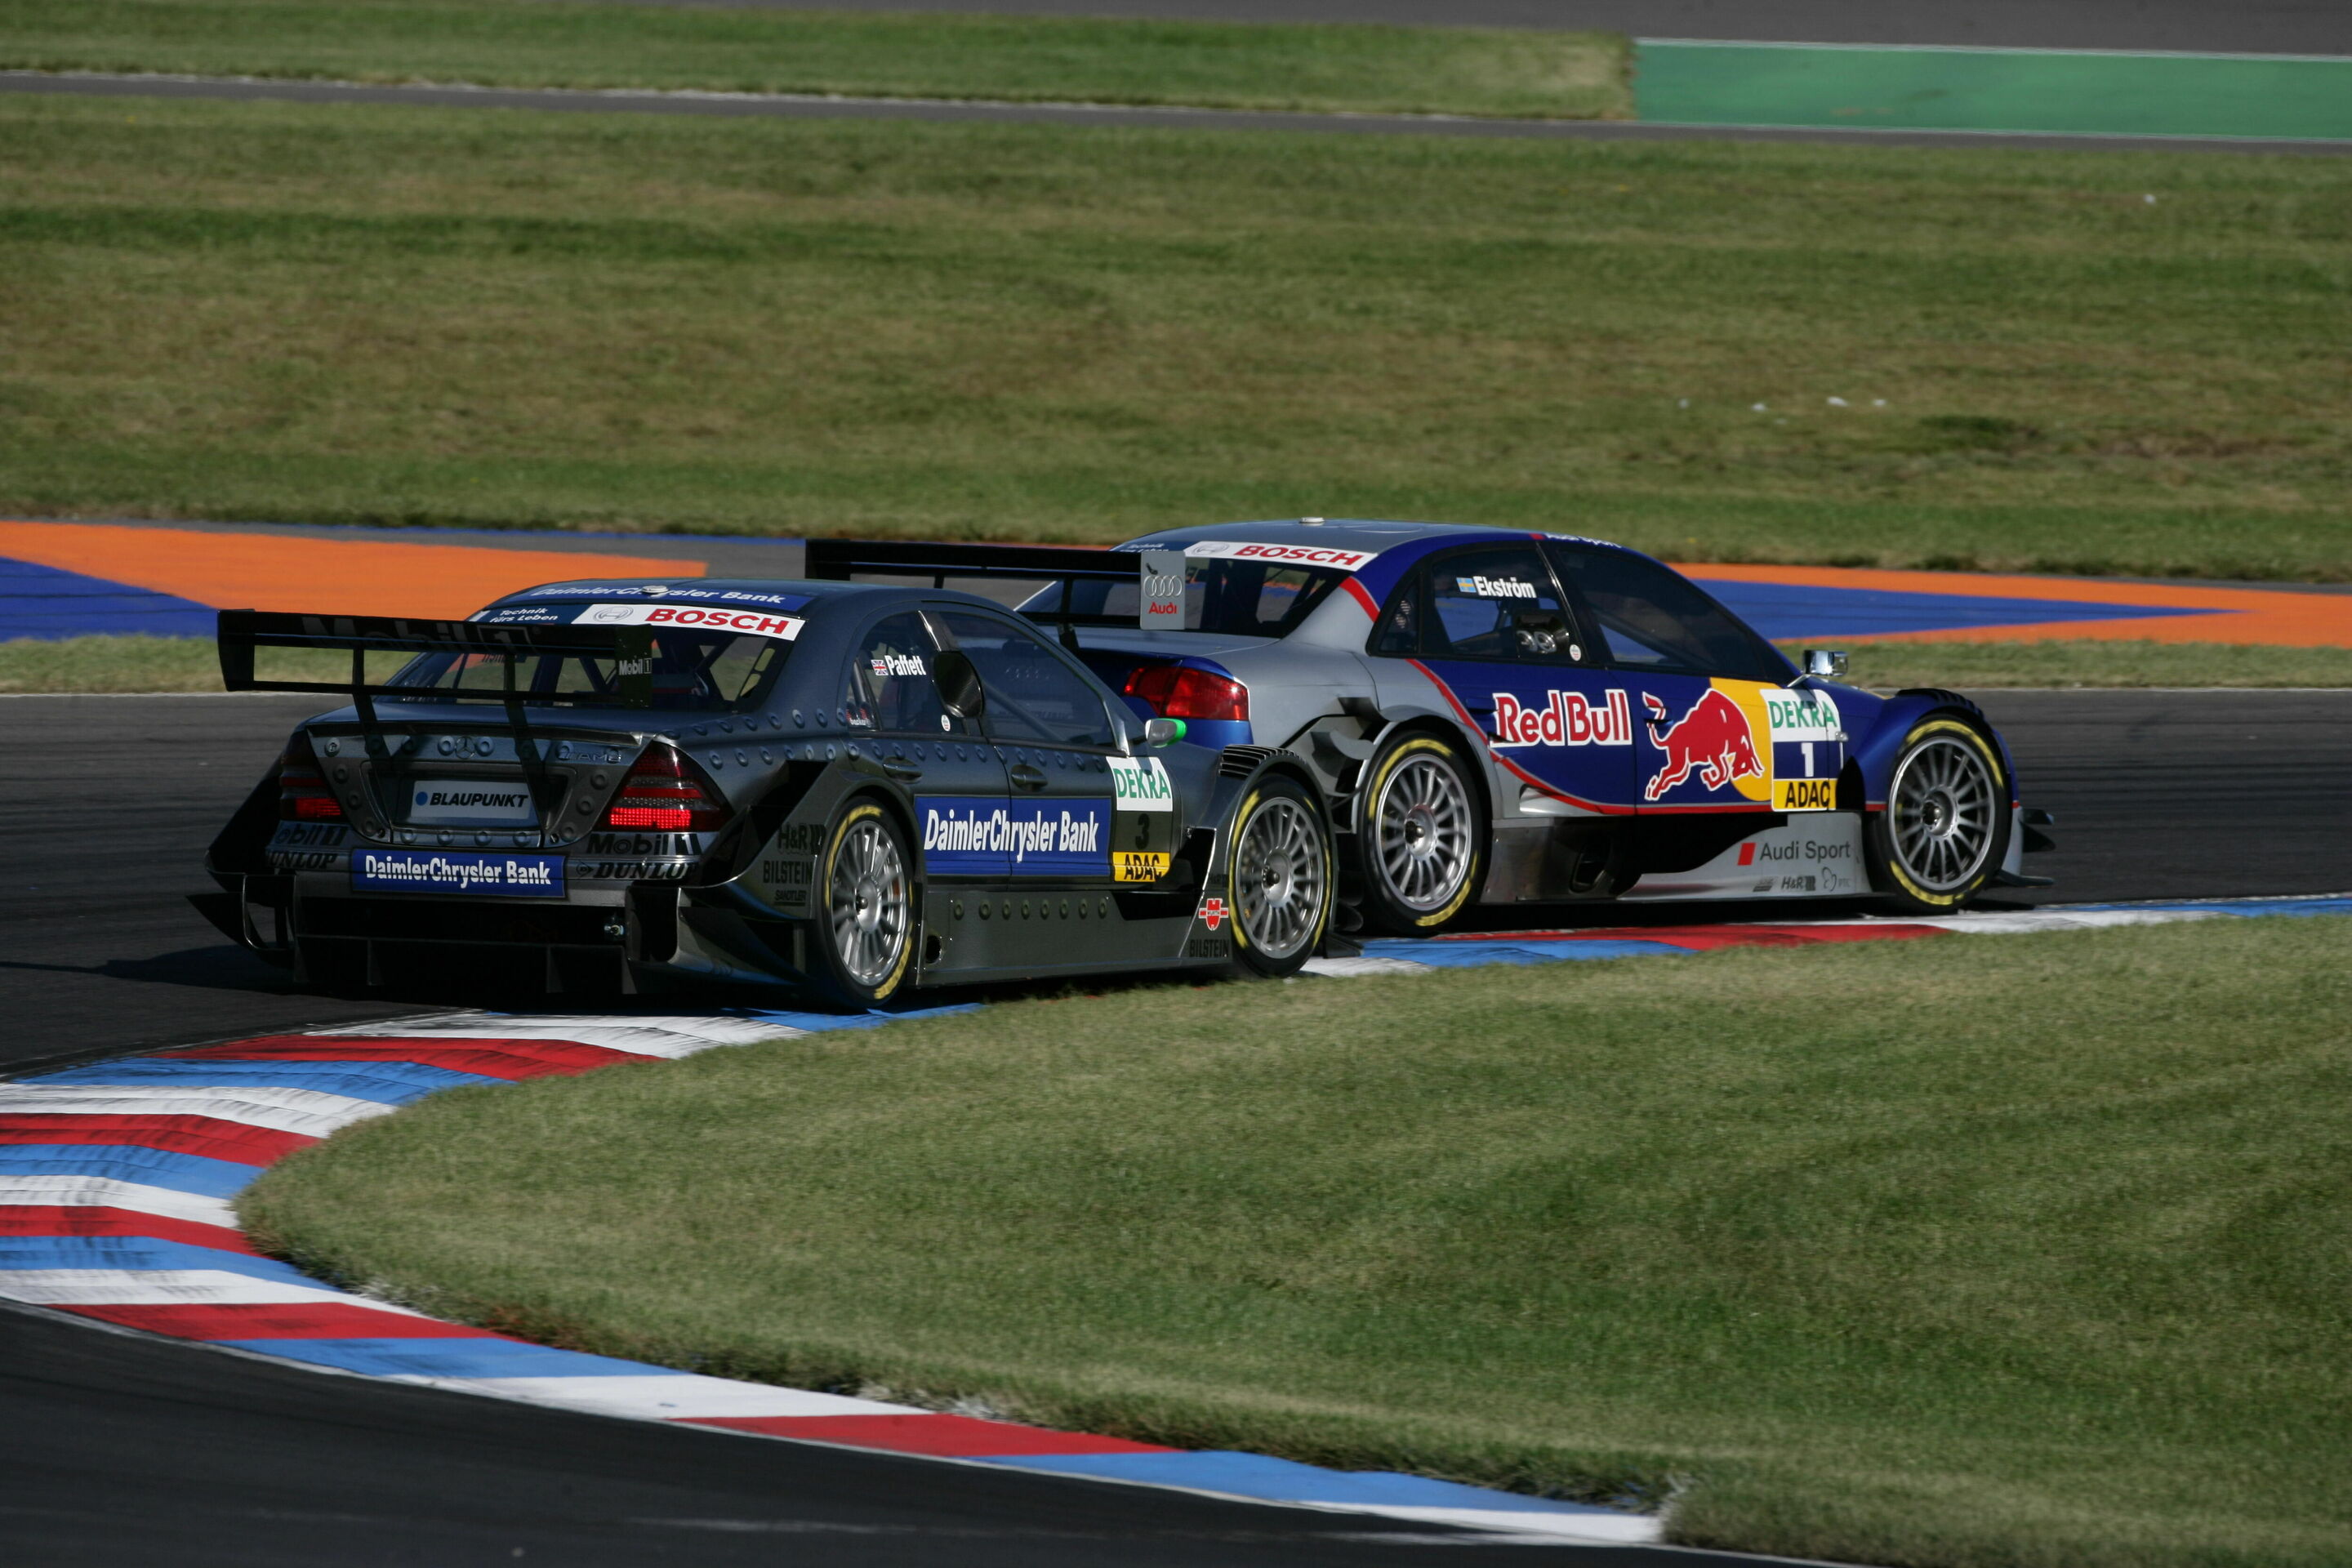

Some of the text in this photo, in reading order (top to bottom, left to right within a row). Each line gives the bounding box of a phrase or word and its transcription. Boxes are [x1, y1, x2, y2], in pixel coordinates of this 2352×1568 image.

[1233, 545, 1363, 566] BOSCH
[720, 591, 786, 604] Bank
[1472, 576, 1537, 599] Ekström
[500, 608, 548, 616] Technik
[1148, 601, 1178, 614] Audi
[645, 608, 790, 634] BOSCH
[619, 658, 644, 675] Mobil
[884, 655, 926, 676] Paffett
[1493, 690, 1631, 745] Red Bull
[1769, 701, 1838, 728] DEKRA
[1801, 742, 1814, 777] 1
[1112, 768, 1171, 799] DEKRA
[1785, 781, 1831, 808] ADAC
[430, 792, 528, 807] BLAUPUNKT
[275, 823, 323, 844] obil
[777, 824, 807, 849] H&R
[924, 808, 1099, 863] DaimlerChrysler Bank
[1135, 813, 1150, 850] 3
[586, 834, 668, 855] Mobil
[1760, 840, 1851, 863] Audi Sport
[265, 851, 338, 868] UNLOP
[1124, 854, 1163, 880] ADAC
[365, 855, 551, 889] DaimlerChrysler Bank
[763, 860, 813, 884] BILSTEIN
[1781, 876, 1803, 889] H&R
[1189, 939, 1229, 958] BILSTEIN
